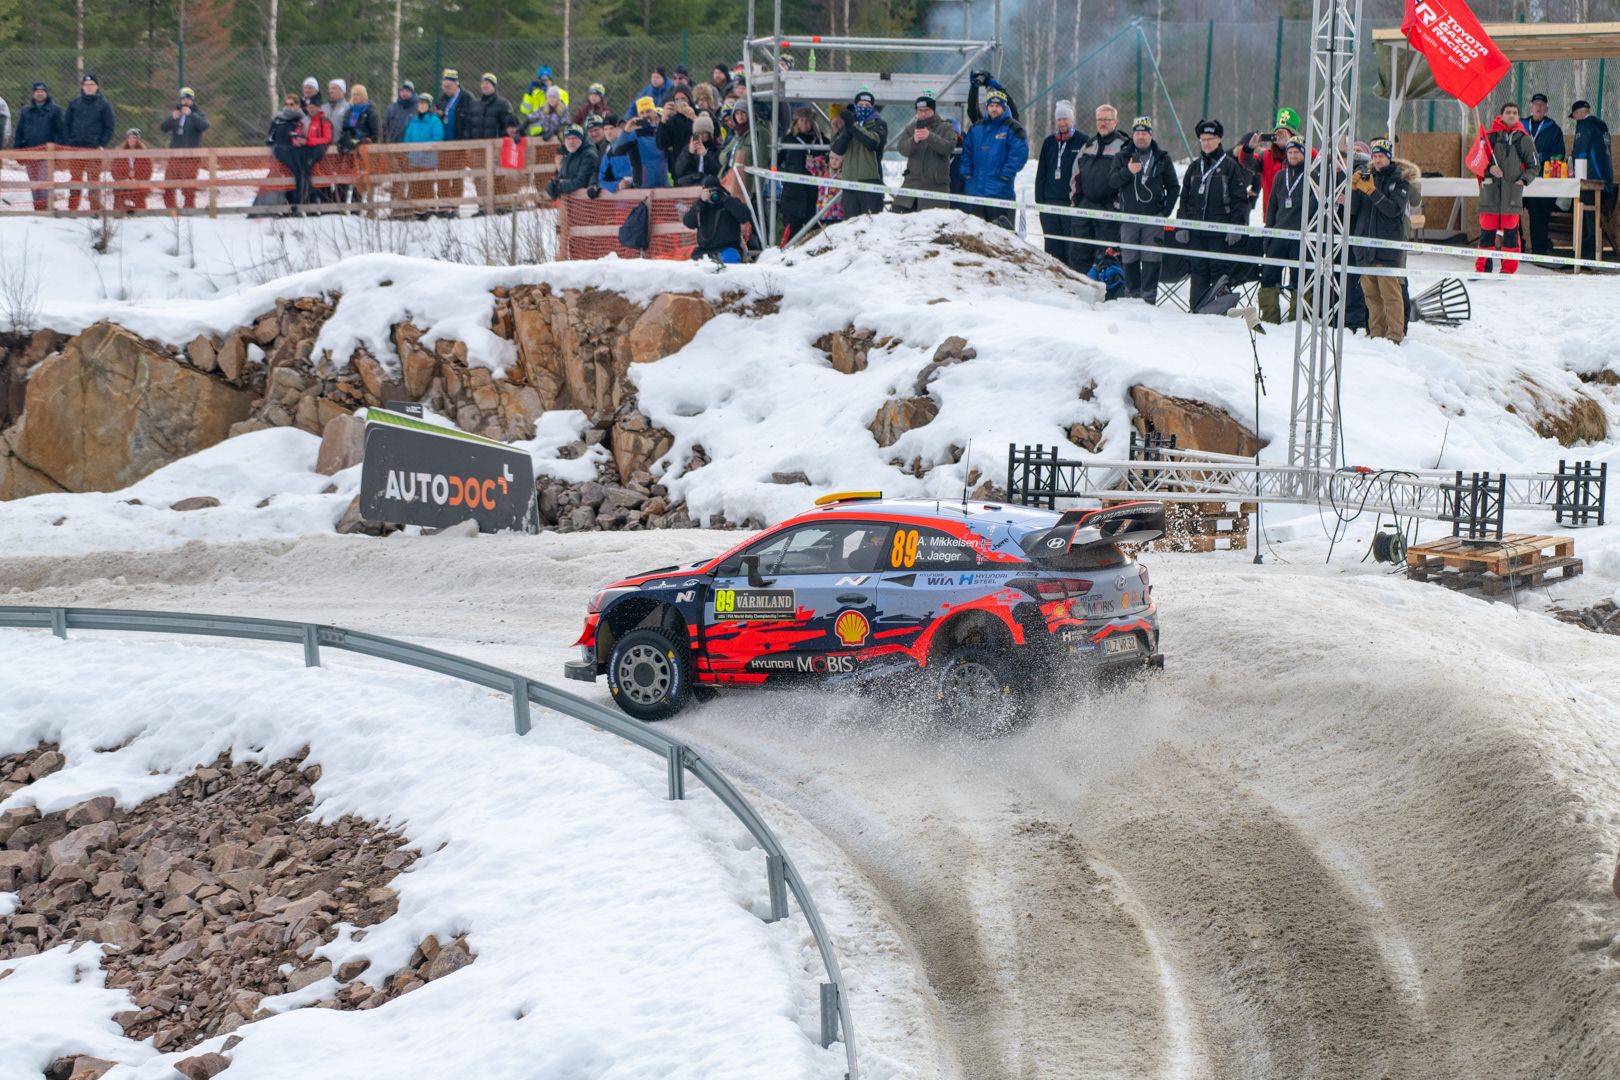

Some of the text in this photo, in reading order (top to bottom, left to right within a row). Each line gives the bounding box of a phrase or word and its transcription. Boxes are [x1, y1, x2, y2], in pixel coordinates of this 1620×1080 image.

[1432, 26, 1470, 64] Racing
[1438, 22, 1478, 58] GAZOO
[1446, 16, 1488, 56] TOYOTA
[406, 406, 422, 414] WRC
[385, 470, 496, 510] AUTODOC
[891, 529, 919, 568] 89
[916, 537, 978, 547] A. Mikkelsen
[915, 551, 961, 563] A. Jaeger
[928, 576, 954, 585] WIA
[716, 590, 792, 612] 89 VÄRMLAND
[1088, 600, 1114, 615] MOBIS
[797, 656, 853, 673] MOBIS
